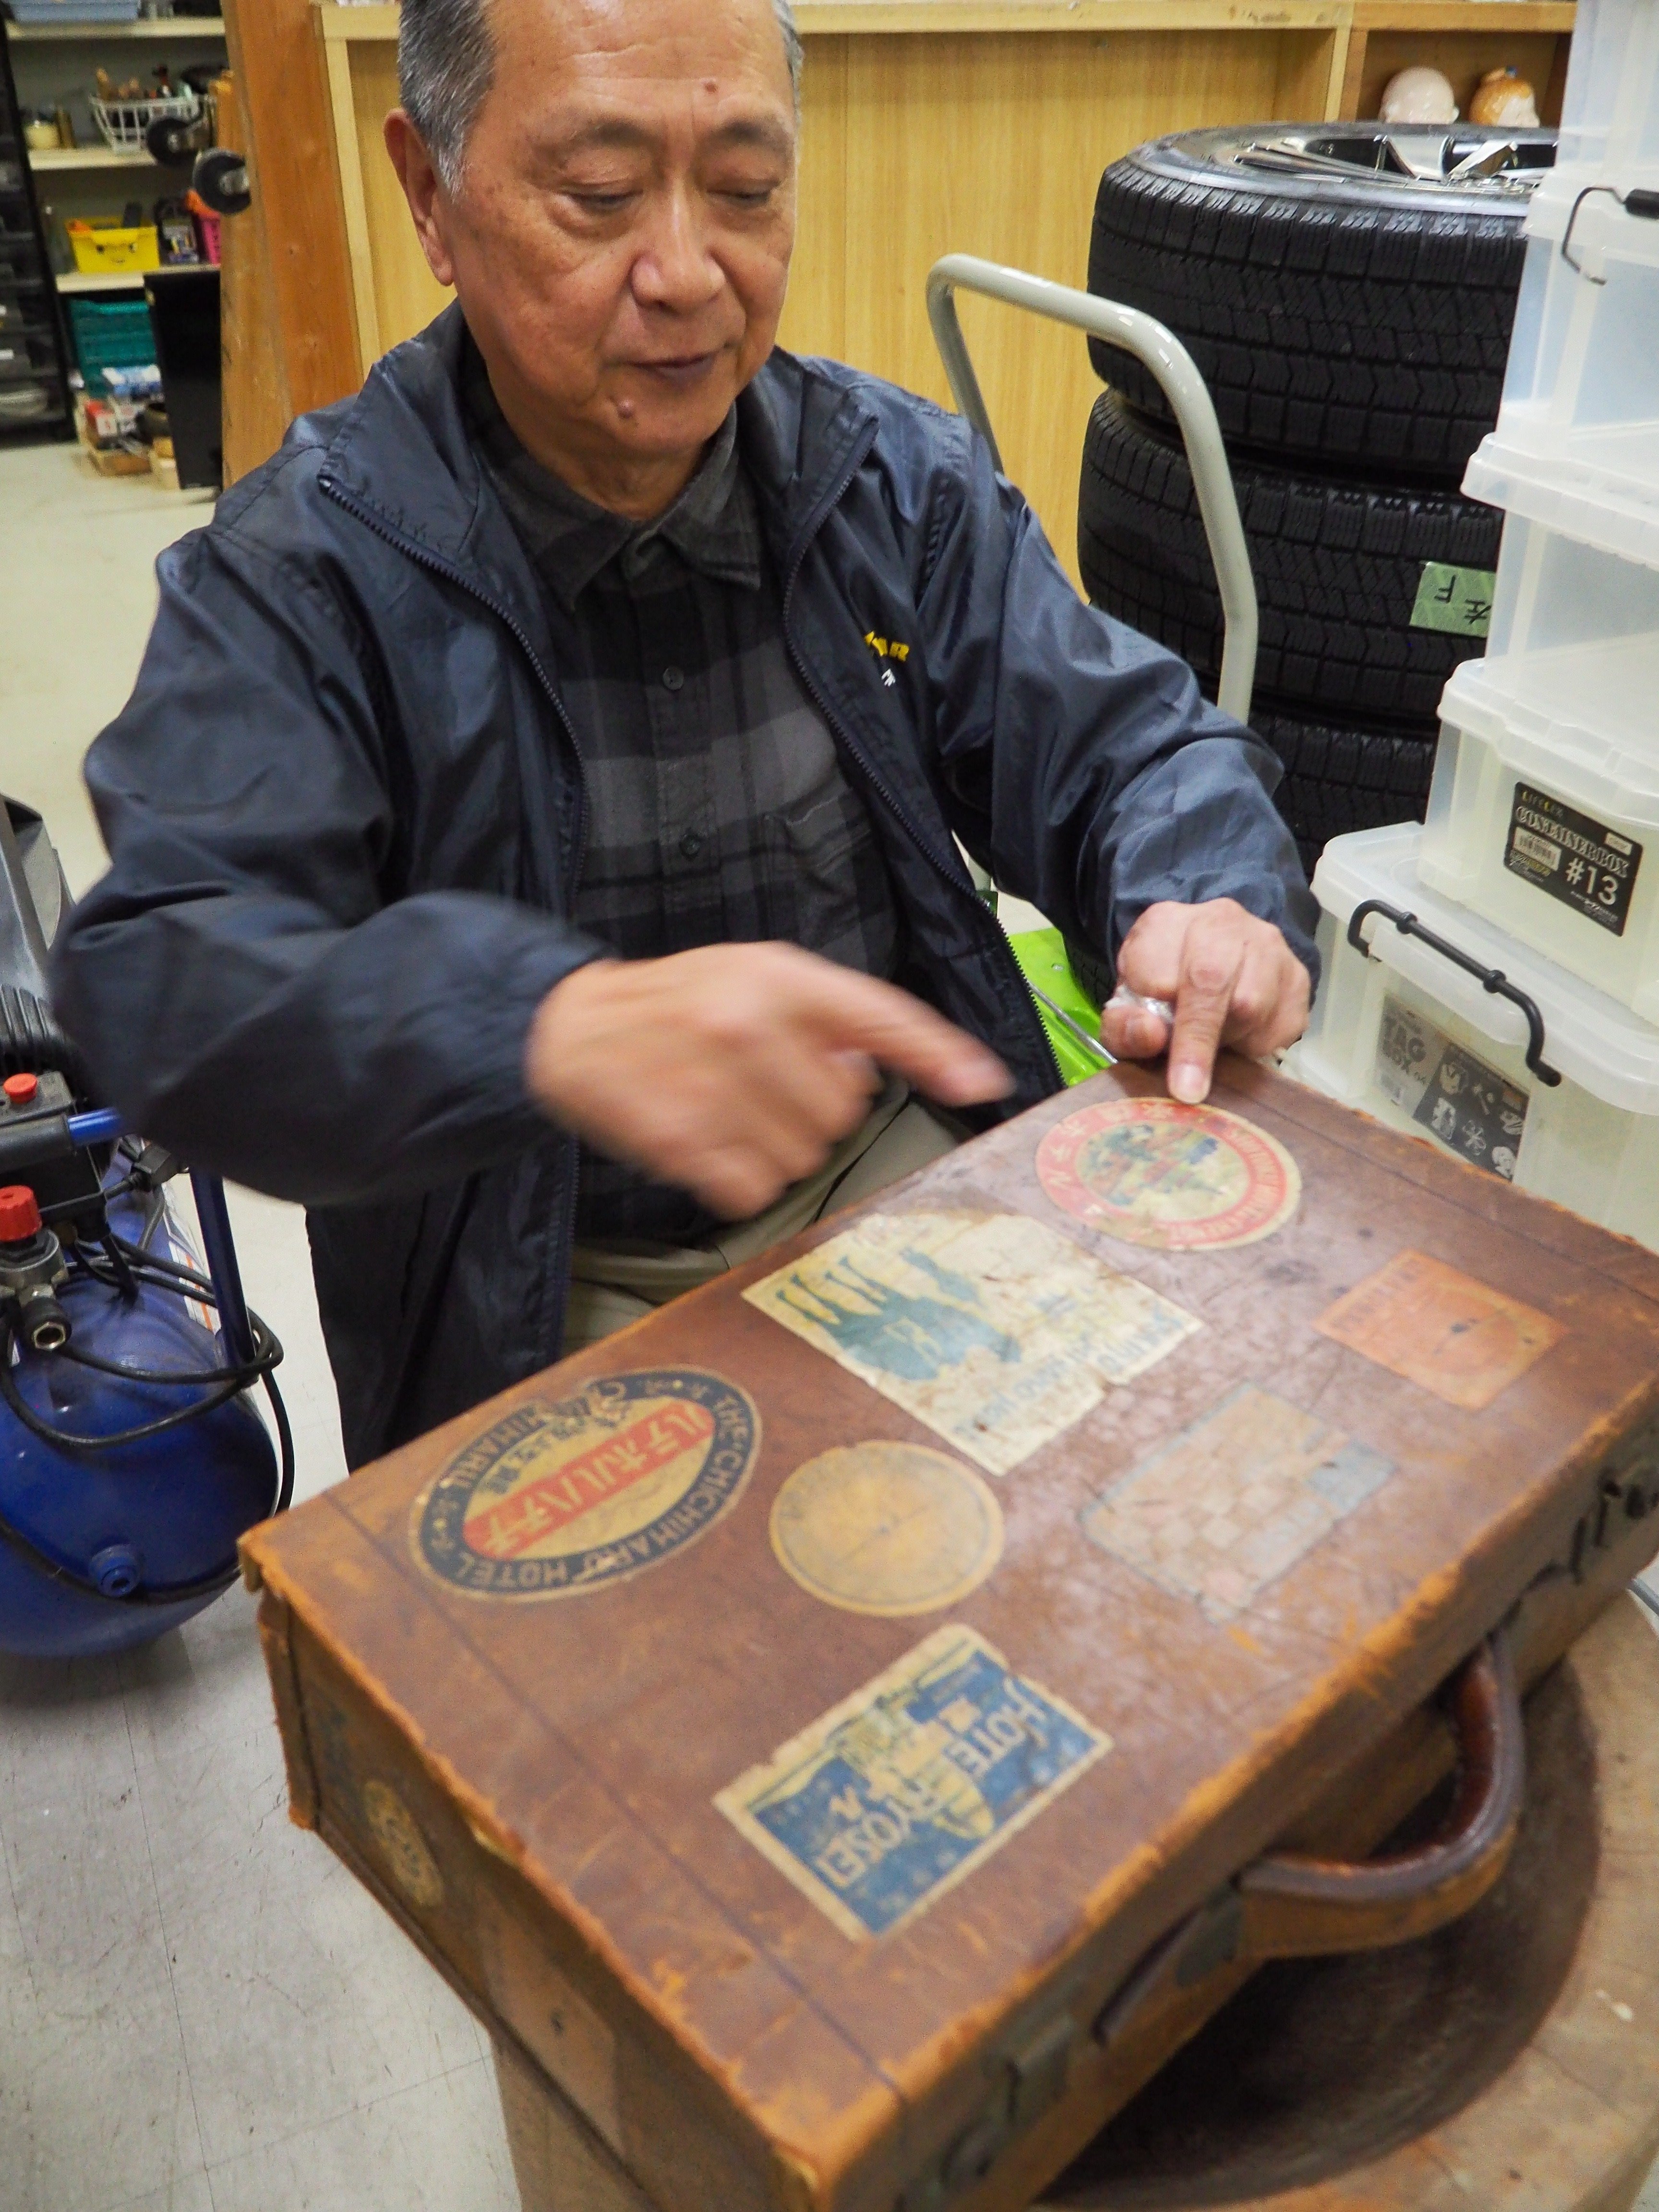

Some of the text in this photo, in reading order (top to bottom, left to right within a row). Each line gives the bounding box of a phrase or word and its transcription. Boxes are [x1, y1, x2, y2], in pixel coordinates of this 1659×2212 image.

[1434, 575, 1456, 603] F
[1565, 857, 1619, 906] #13
[457, 1551, 568, 1588] HOTEL
